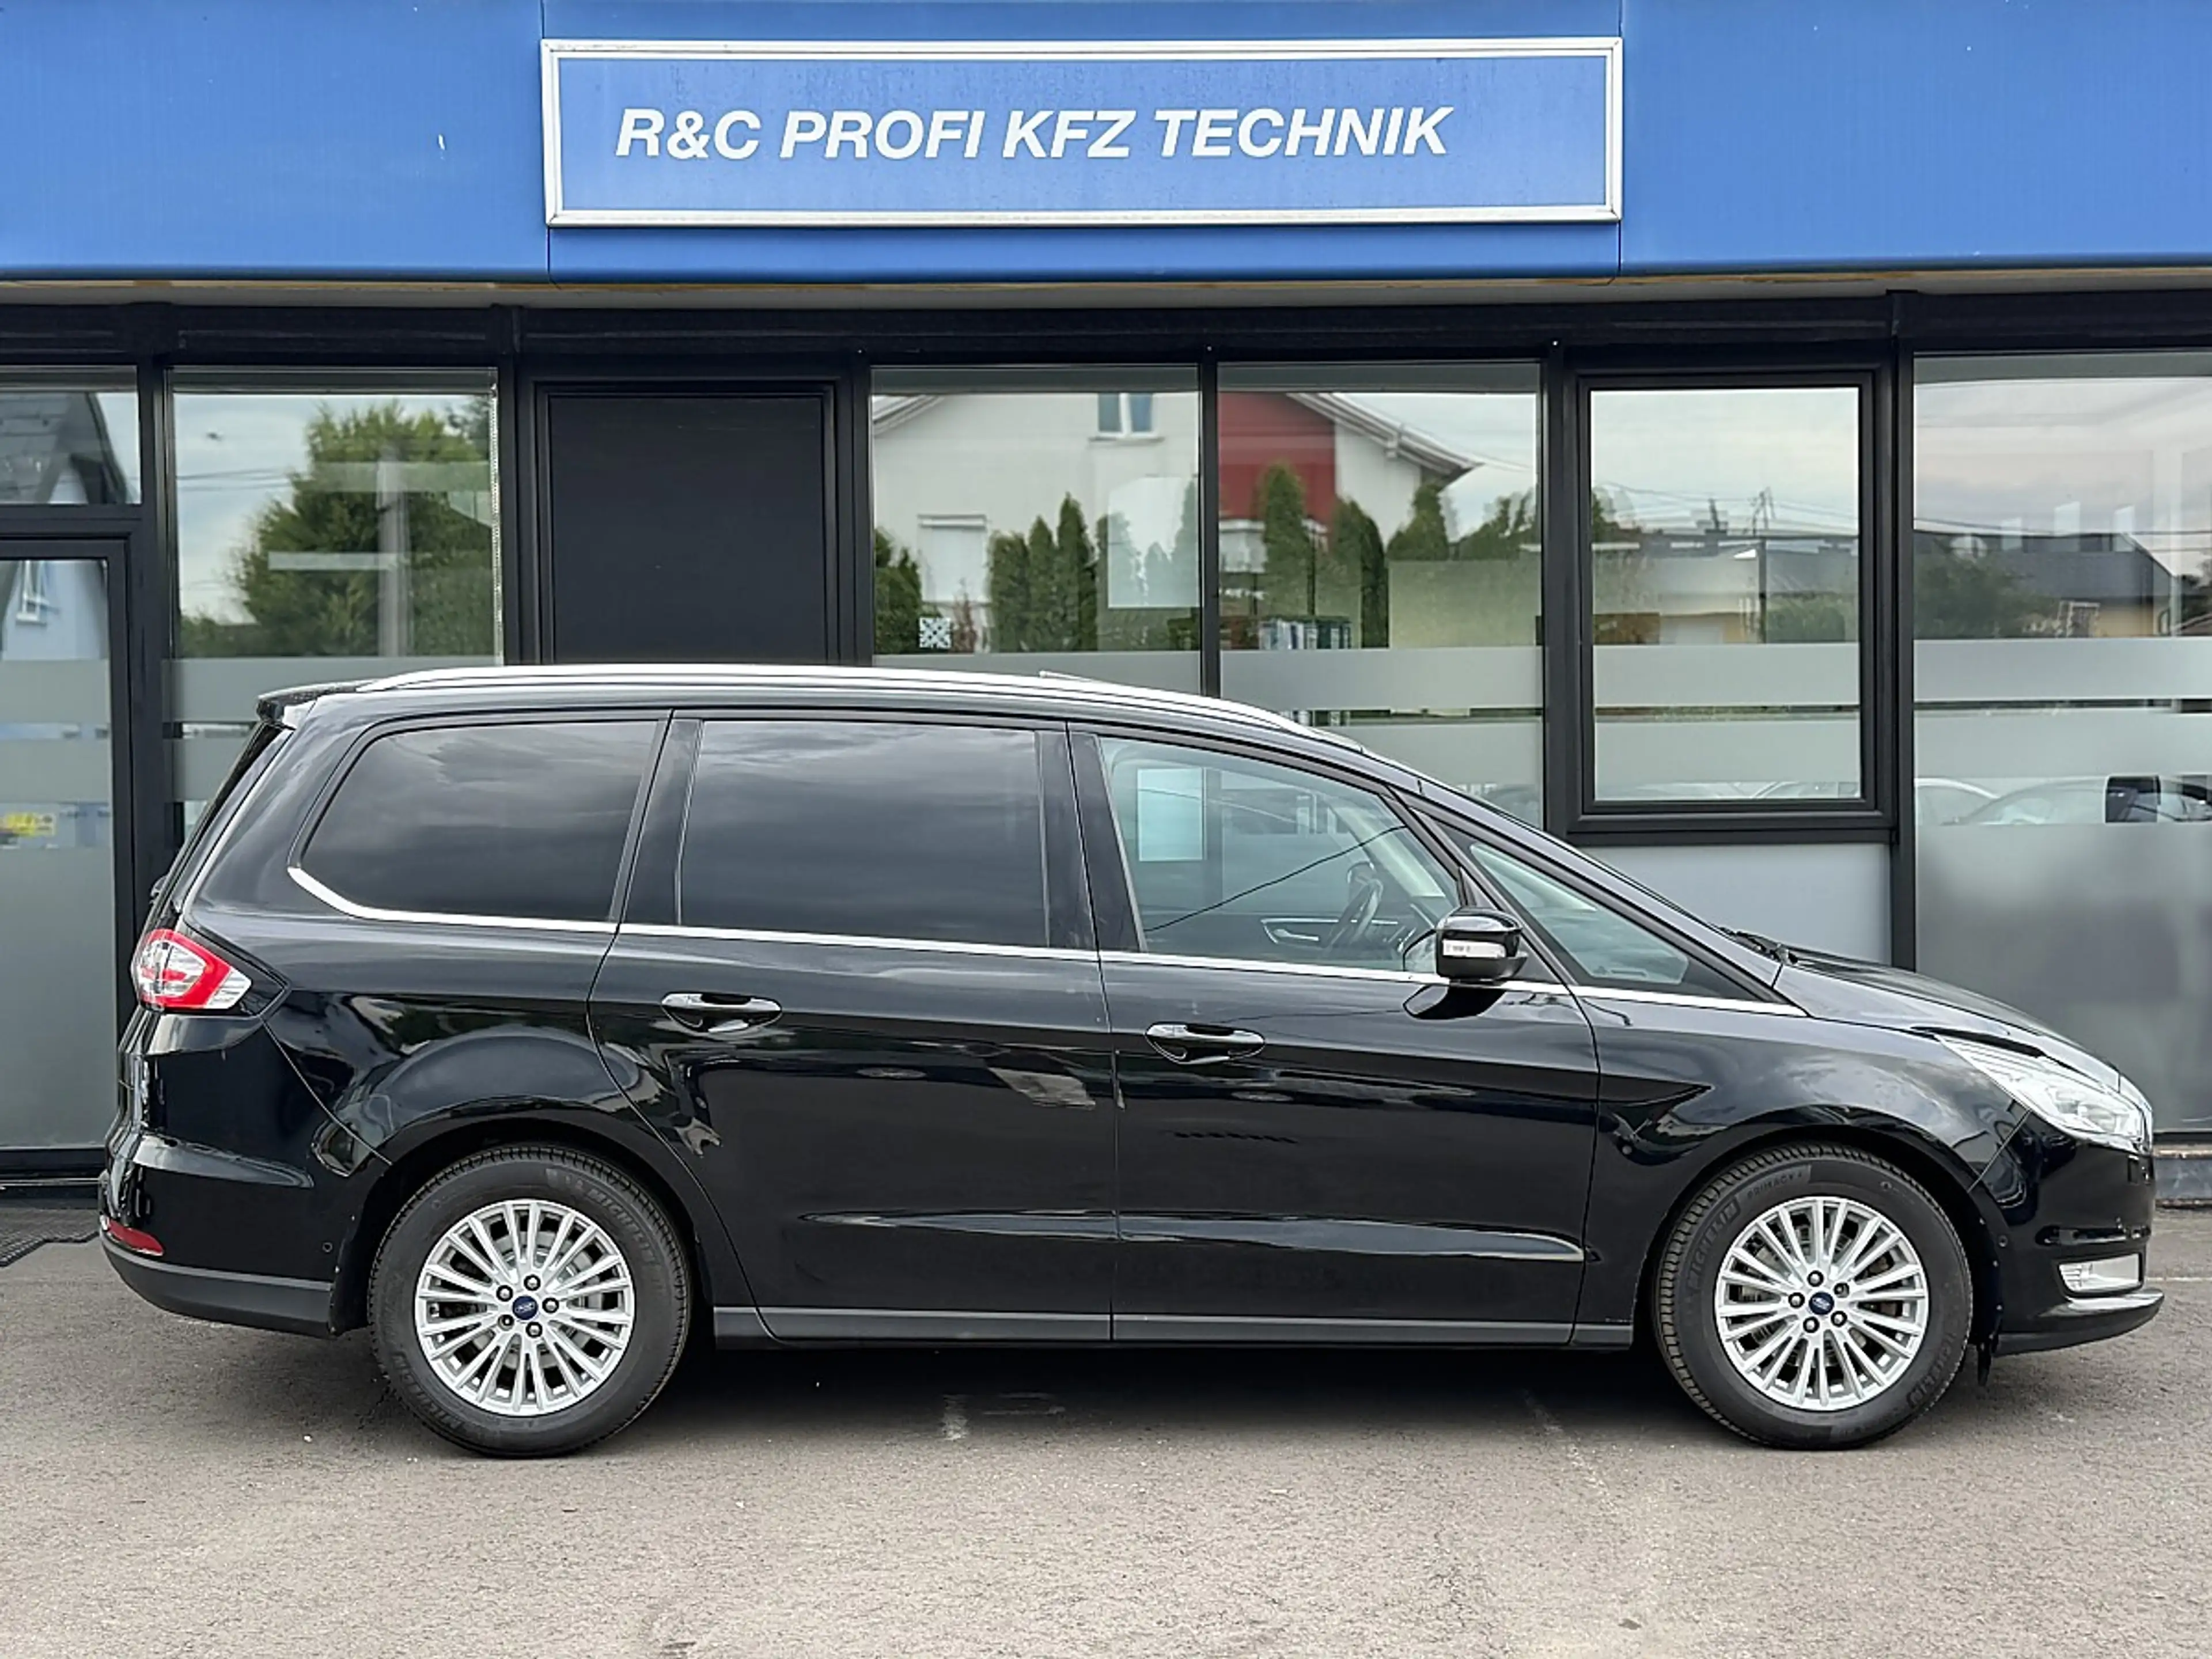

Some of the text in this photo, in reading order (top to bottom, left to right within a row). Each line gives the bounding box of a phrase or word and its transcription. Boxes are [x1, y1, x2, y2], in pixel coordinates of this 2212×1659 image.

[616, 108, 1455, 158] R&C PROFI KFZ TECHNIK
